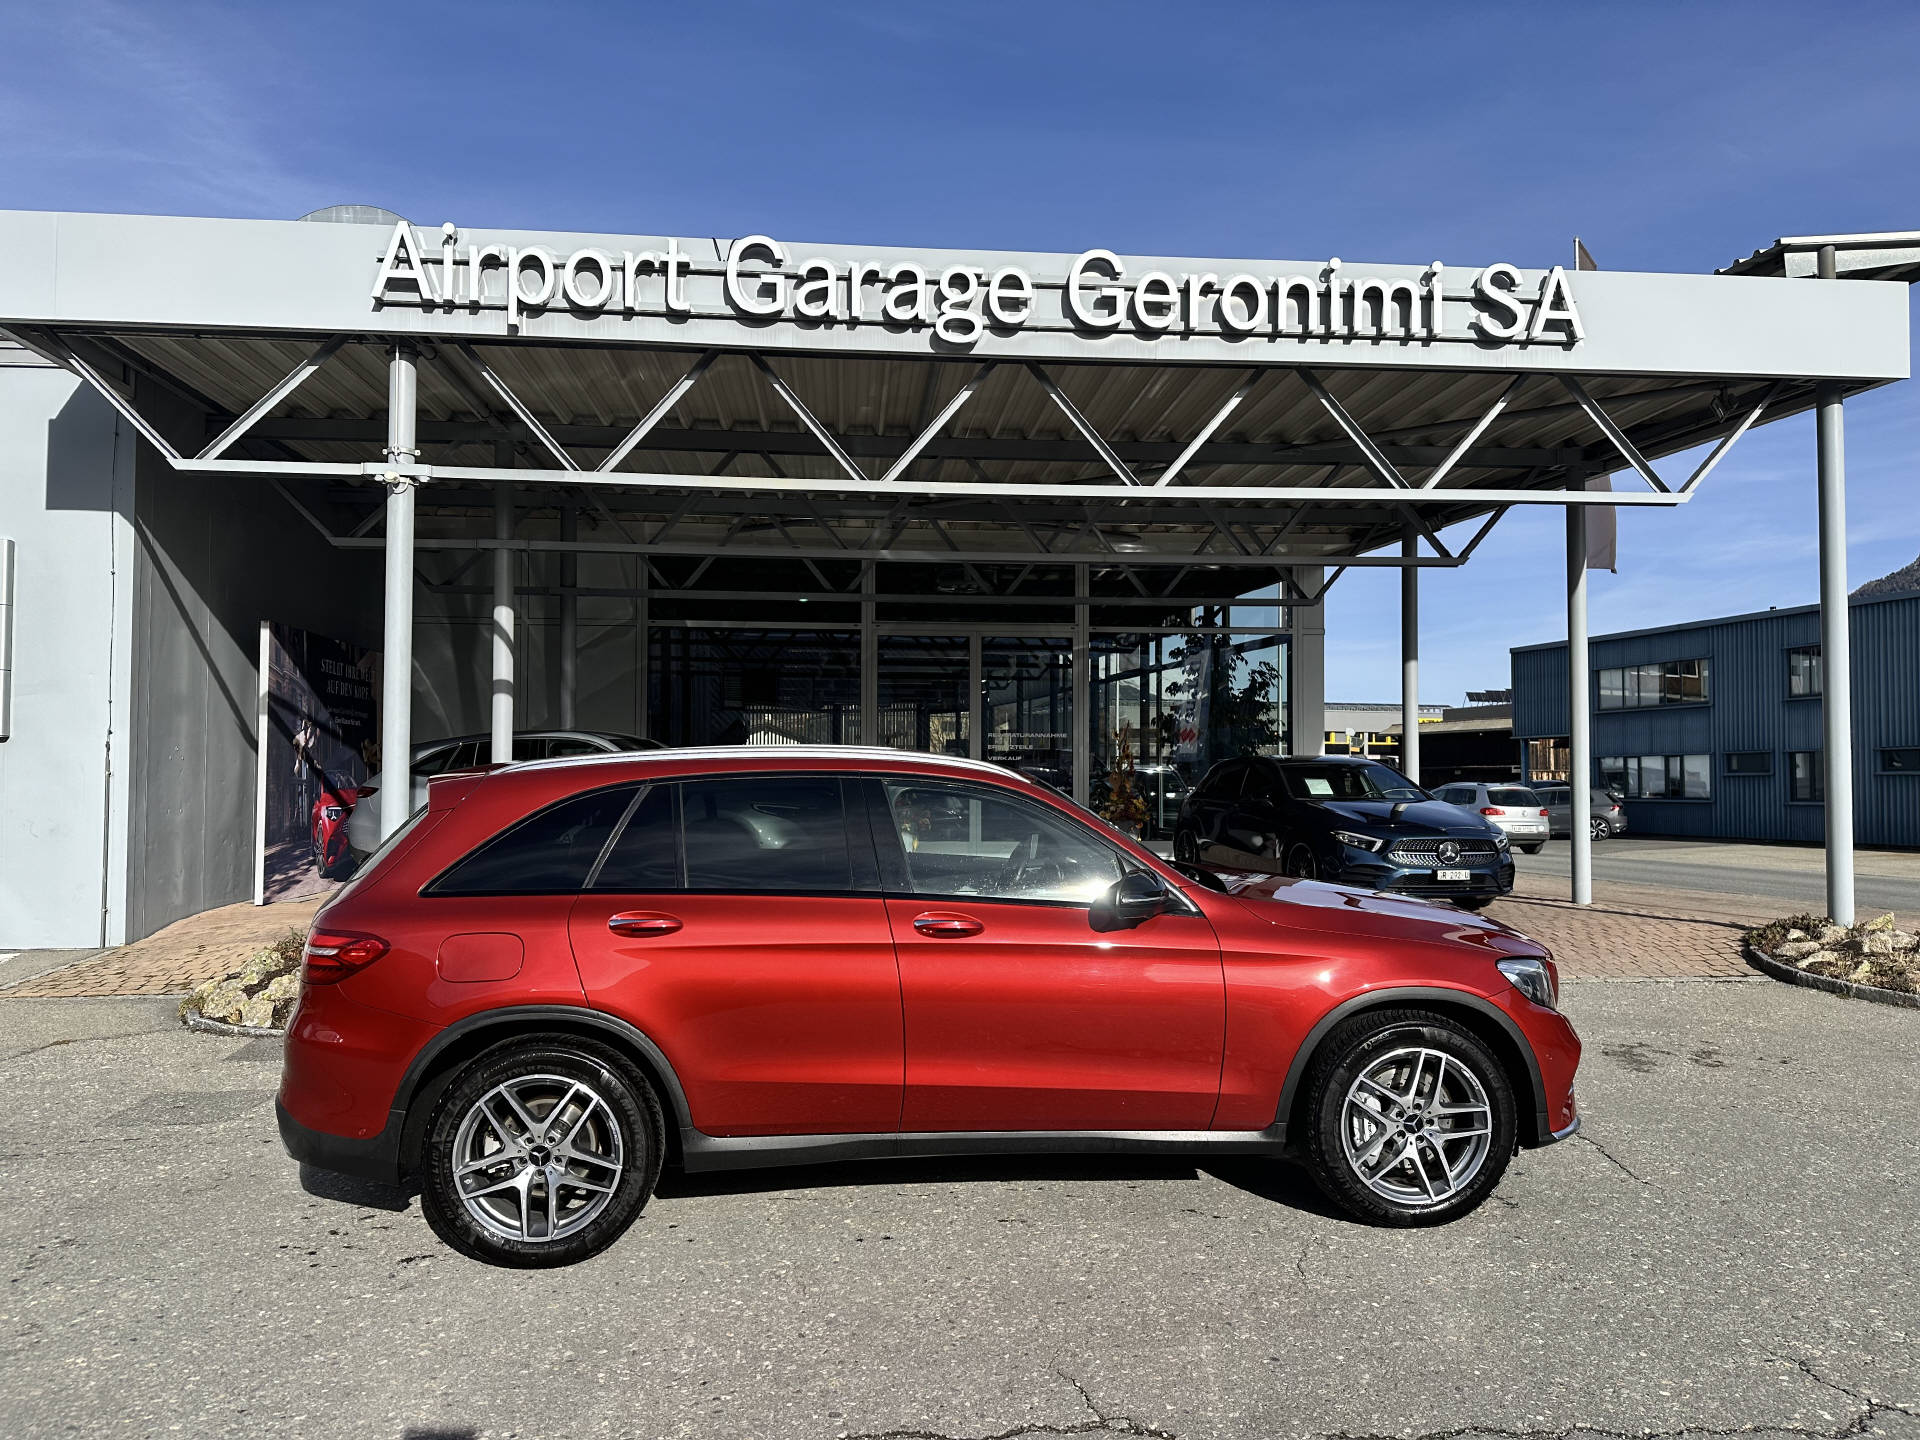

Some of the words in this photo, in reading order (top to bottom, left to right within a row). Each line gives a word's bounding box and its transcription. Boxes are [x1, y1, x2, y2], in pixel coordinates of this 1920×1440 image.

[372, 219, 693, 326] Airport
[725, 234, 1034, 344] Garage
[1067, 248, 1444, 338] Geronimi
[1475, 262, 1586, 340] SA
[326, 679, 339, 695] AUF
